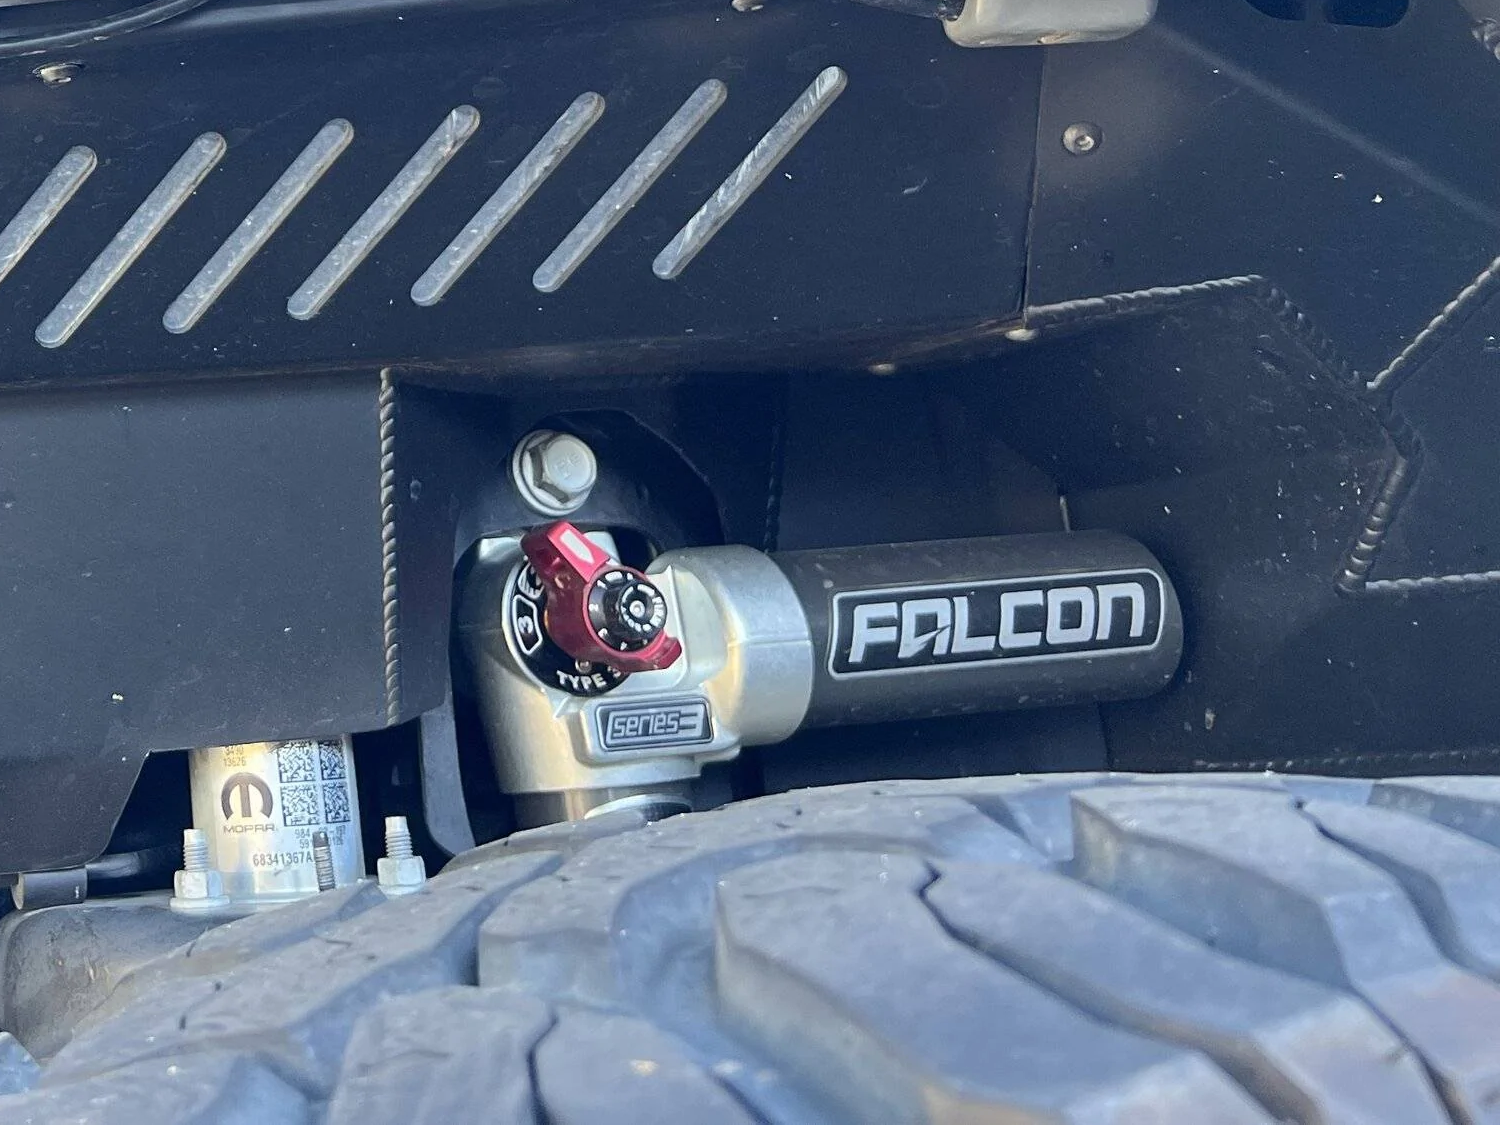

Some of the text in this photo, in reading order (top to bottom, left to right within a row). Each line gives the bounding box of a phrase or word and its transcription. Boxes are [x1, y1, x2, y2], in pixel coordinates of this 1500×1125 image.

[849, 581, 1146, 663] FALCON
[555, 669, 607, 690] TYPE
[223, 823, 275, 833] MOPAR
